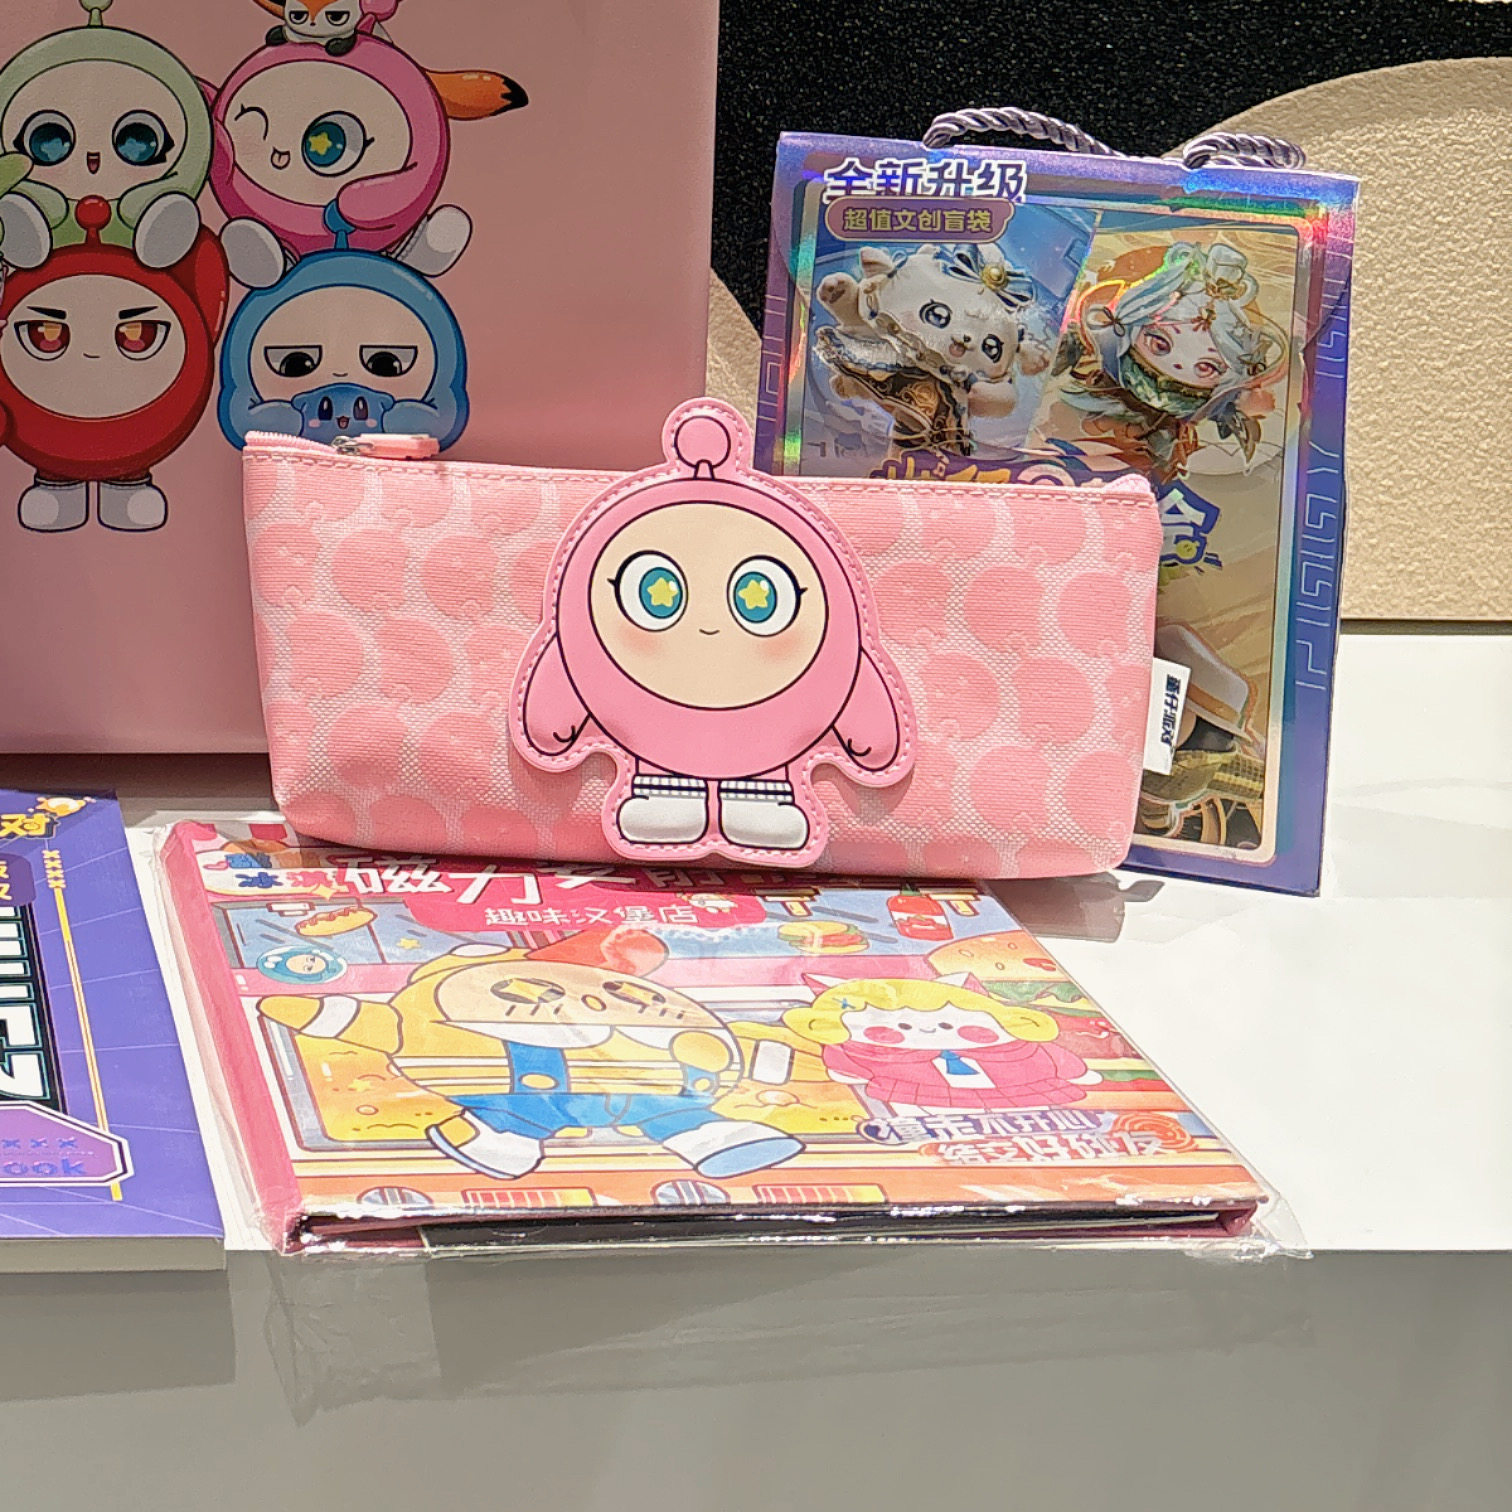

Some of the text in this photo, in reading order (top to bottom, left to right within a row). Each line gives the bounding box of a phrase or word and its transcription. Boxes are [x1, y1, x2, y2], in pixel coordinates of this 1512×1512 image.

[823, 158, 1026, 204] 全新升级
[843, 207, 992, 233] 超值文创盲袋
[1159, 673, 1182, 748] 蛋仔派对
[484, 905, 700, 928] 趣味汉堡店
